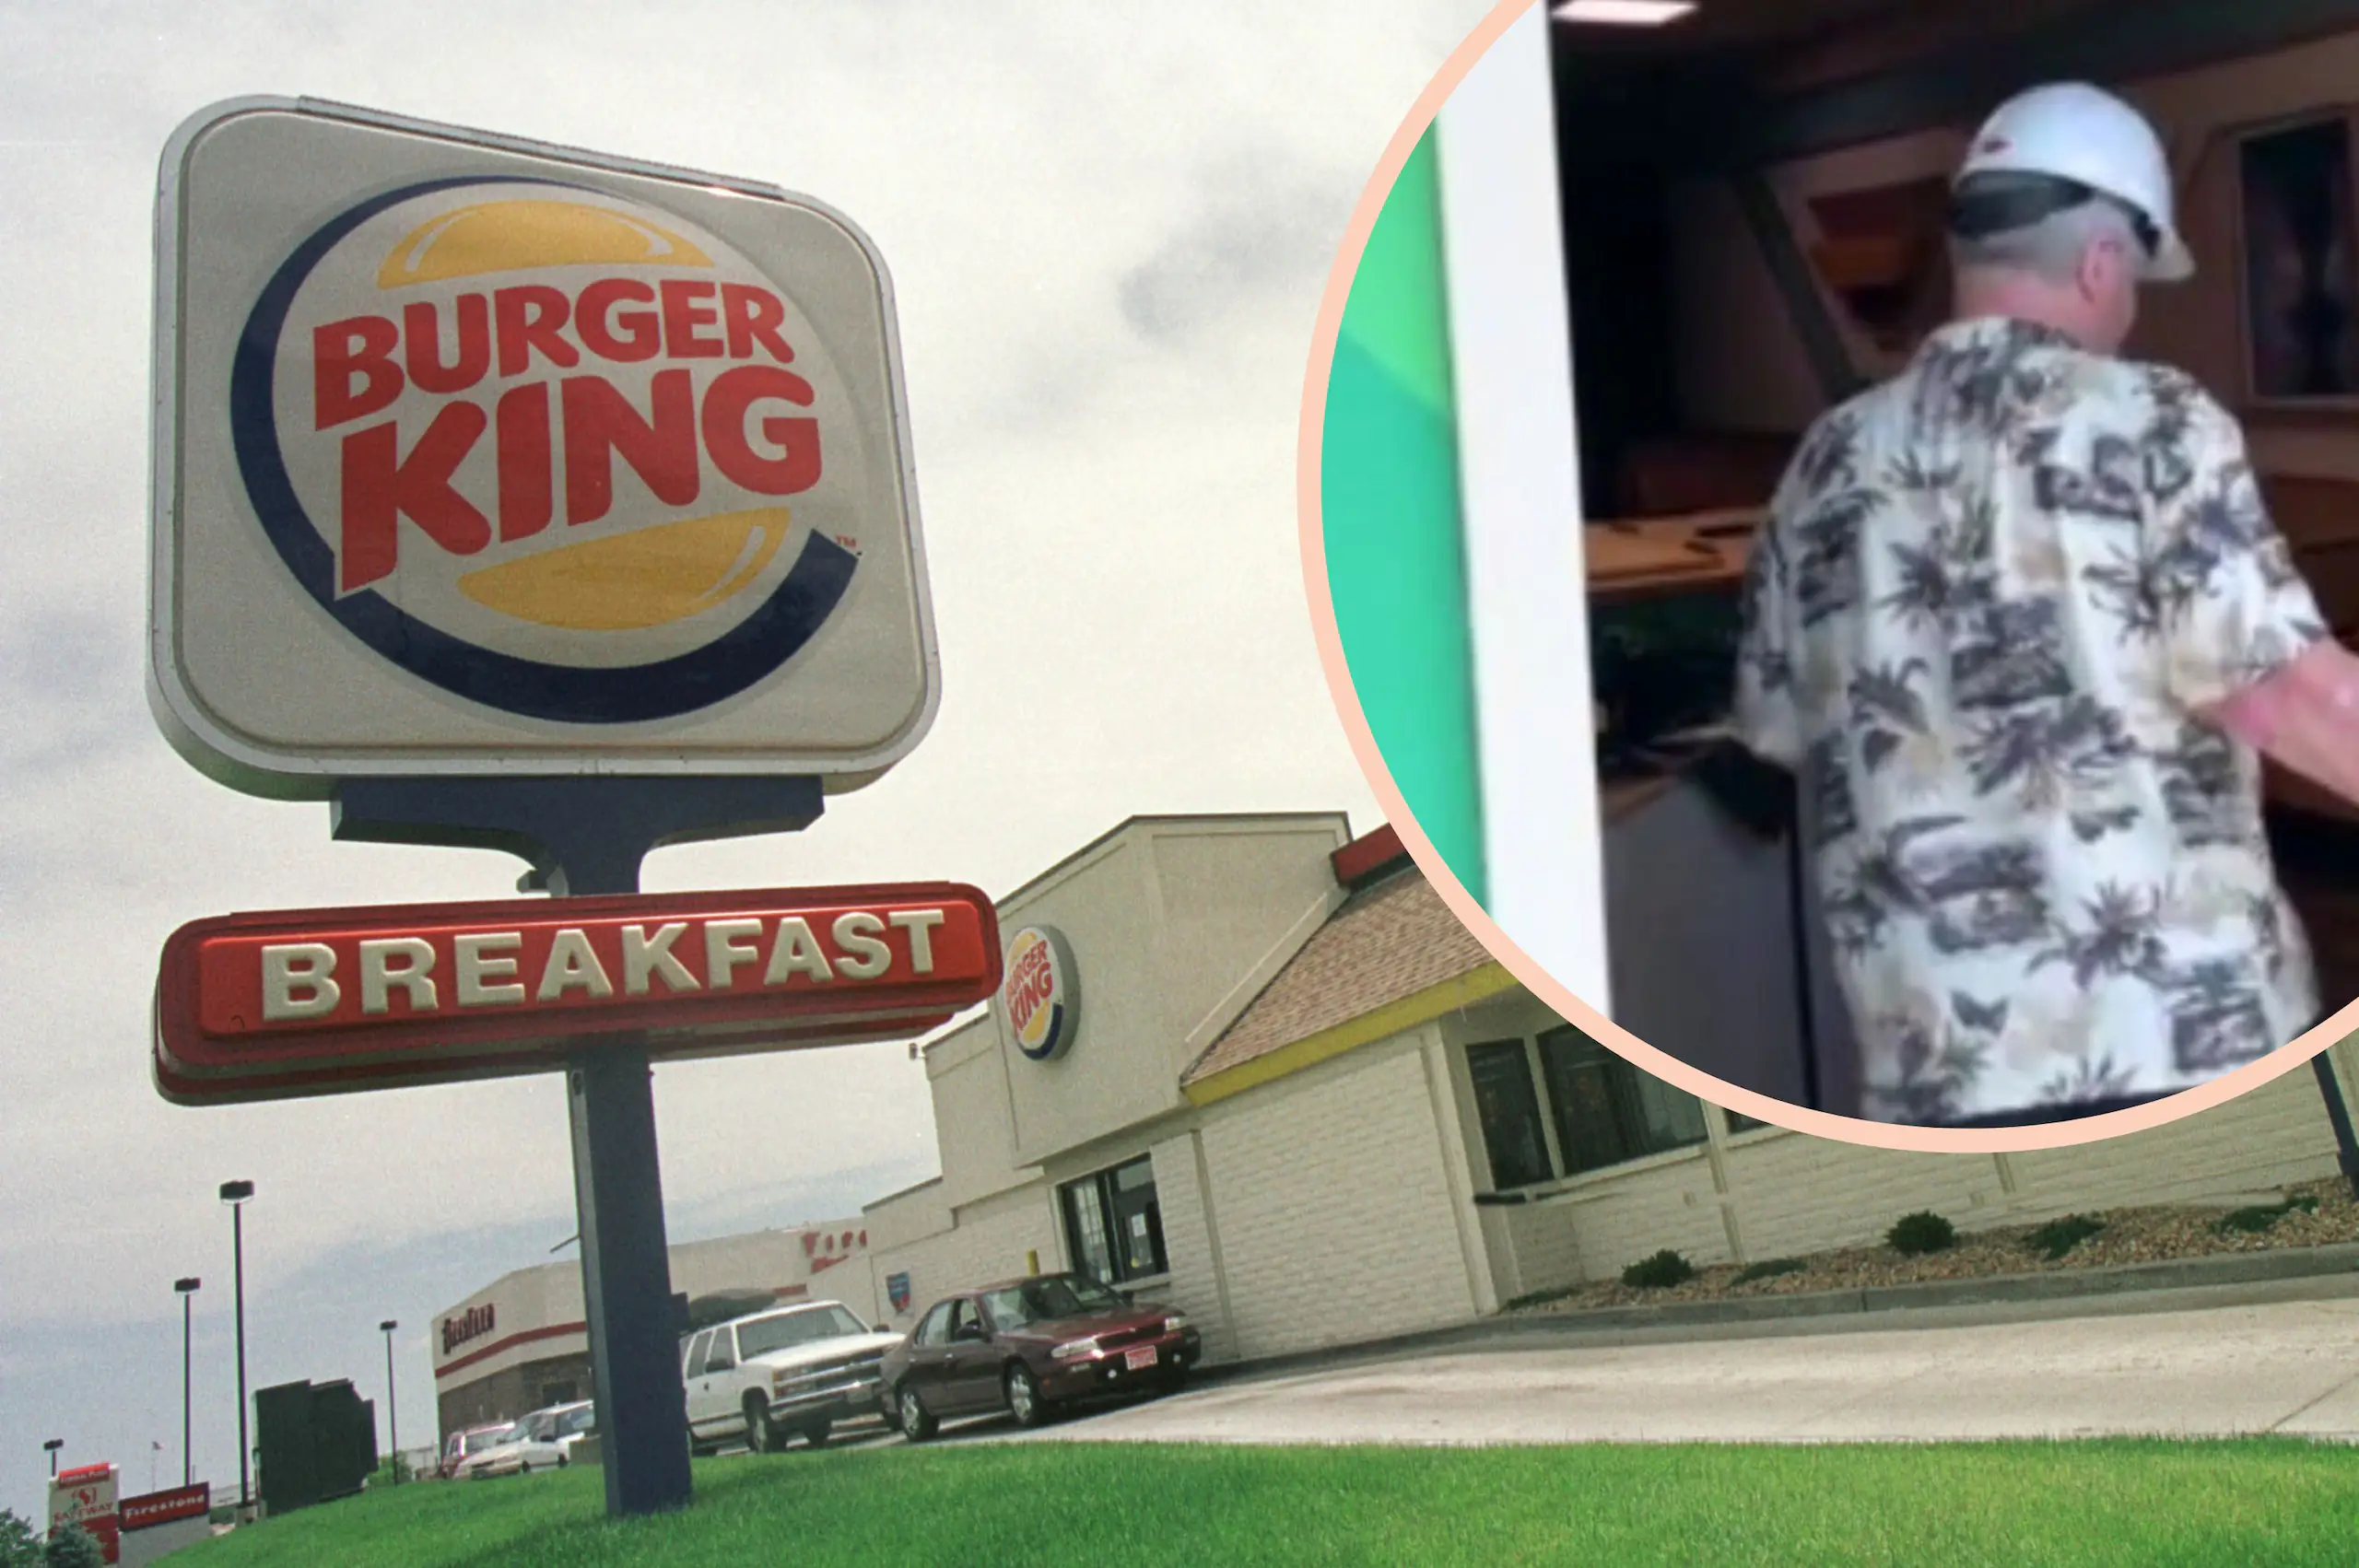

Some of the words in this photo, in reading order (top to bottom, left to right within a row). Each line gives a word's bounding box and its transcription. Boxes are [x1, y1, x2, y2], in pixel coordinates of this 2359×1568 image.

[313, 277, 795, 432] BURGER
[341, 364, 823, 592] KING
[262, 908, 945, 1022] BREAKFAST
[1005, 940, 1048, 1008] BURGER
[1010, 962, 1053, 1040] KING
[123, 1492, 205, 1522] Firestone
